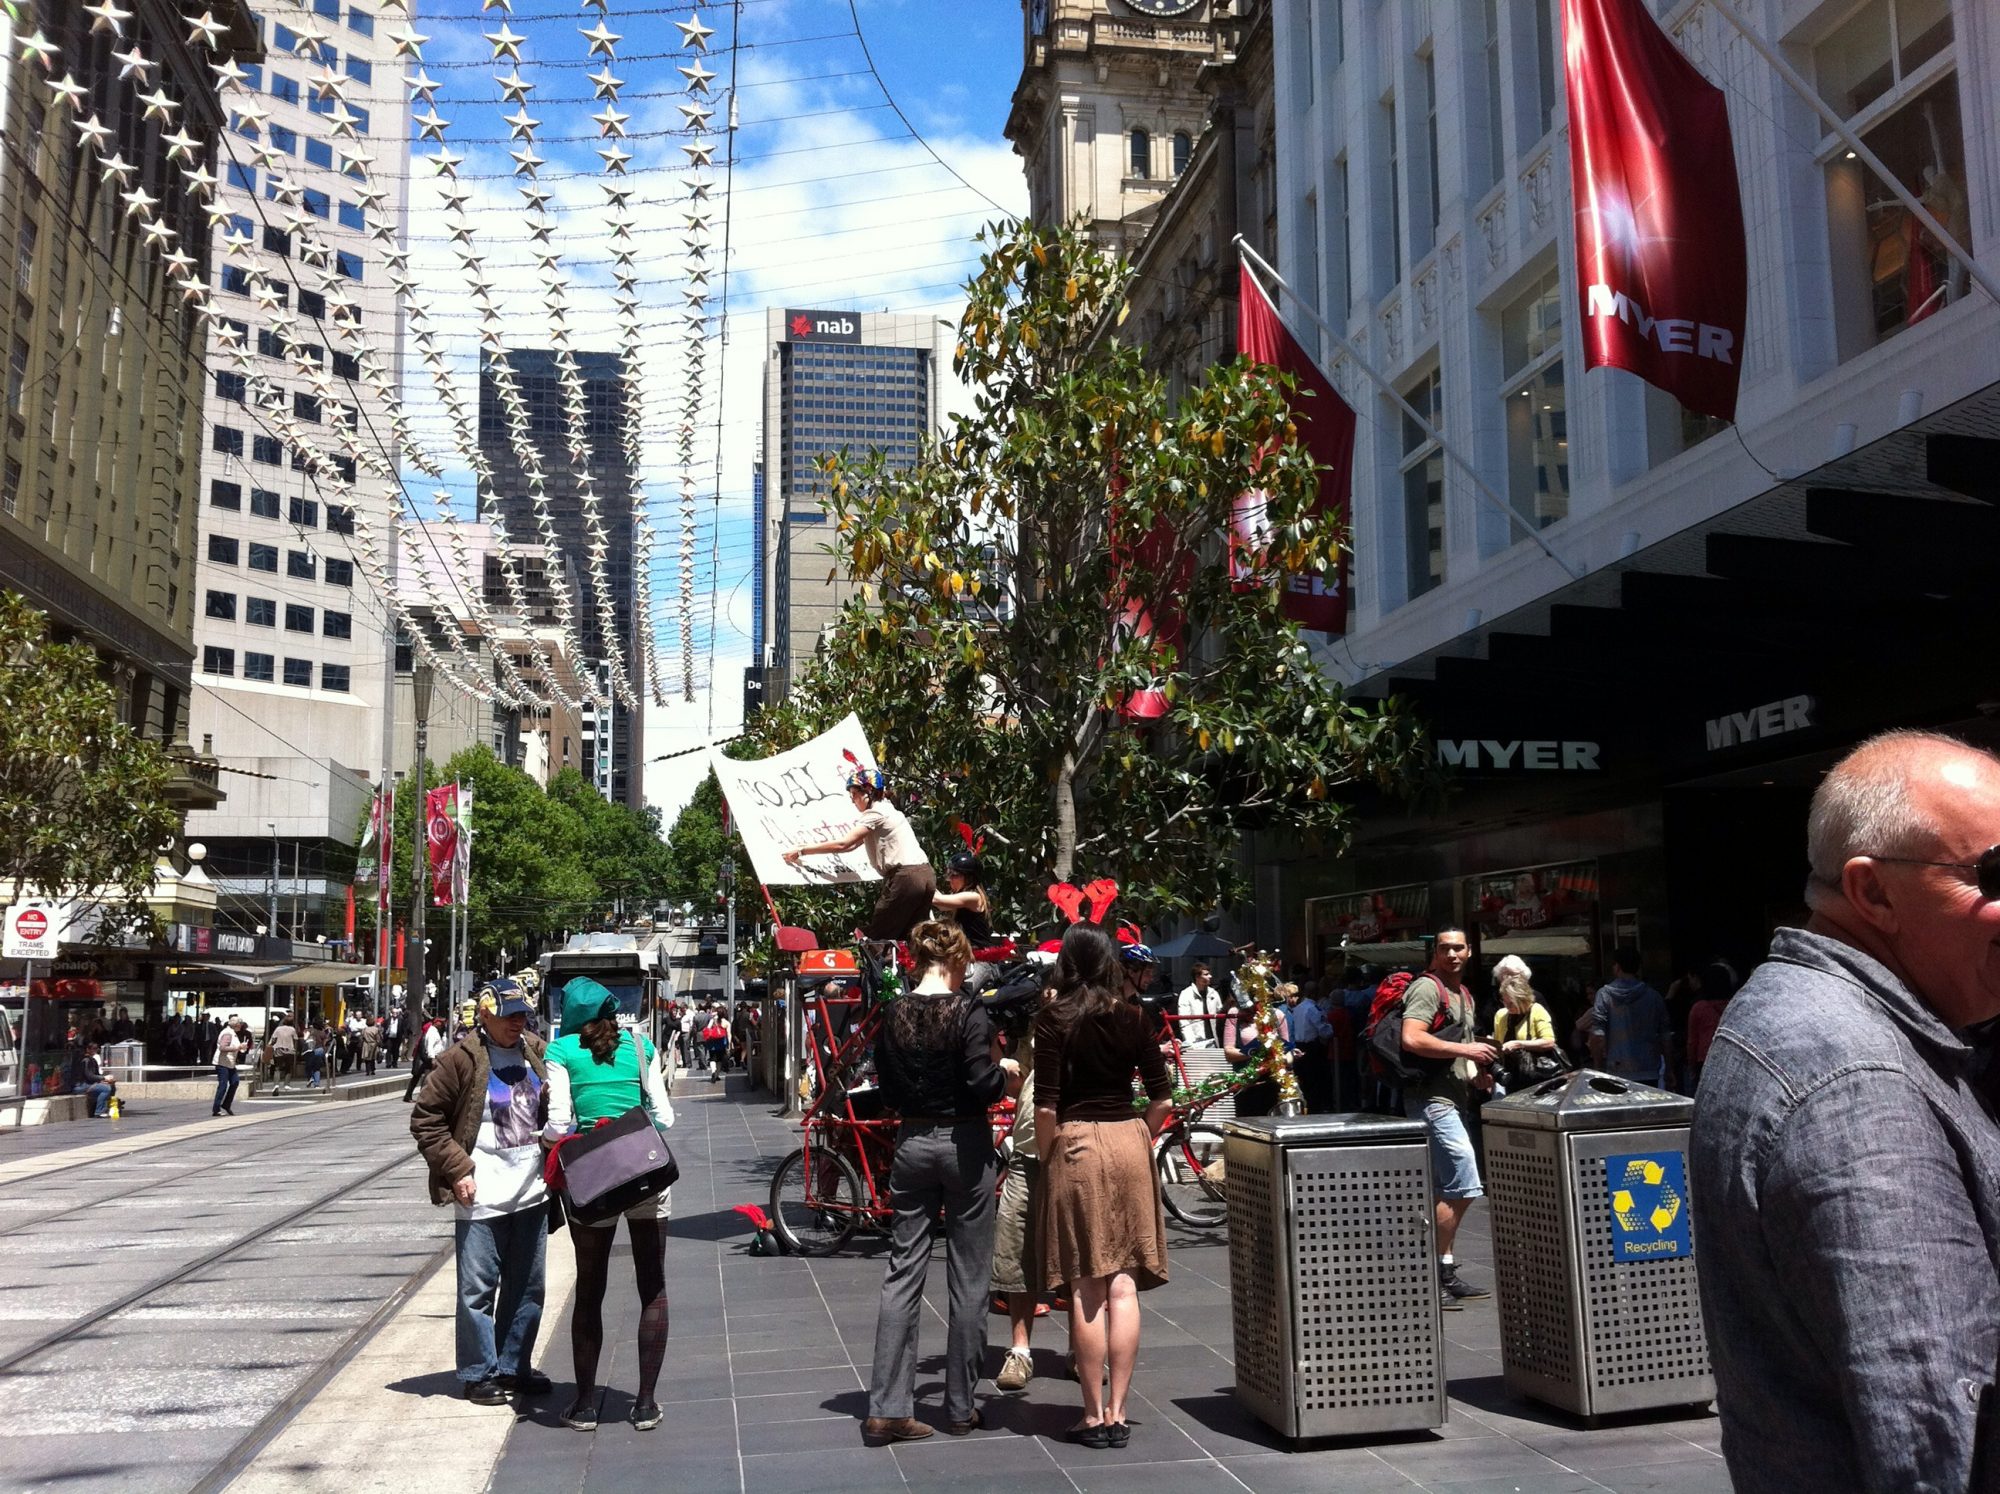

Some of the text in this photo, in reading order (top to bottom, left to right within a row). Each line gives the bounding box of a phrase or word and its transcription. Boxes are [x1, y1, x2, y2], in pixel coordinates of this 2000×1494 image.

[816, 318, 854, 335] nab
[1587, 283, 1734, 366] MYER
[1705, 694, 1813, 752] MYER
[1436, 739, 1602, 770] MYER
[27, 913, 39, 921] NO
[20, 928, 44, 936] ENTRY
[19, 941, 44, 949] TRAMS
[11, 949, 50, 957] EXCEPTED
[53, 959, 97, 971] onald's
[1624, 1239, 1677, 1255] Recycling
